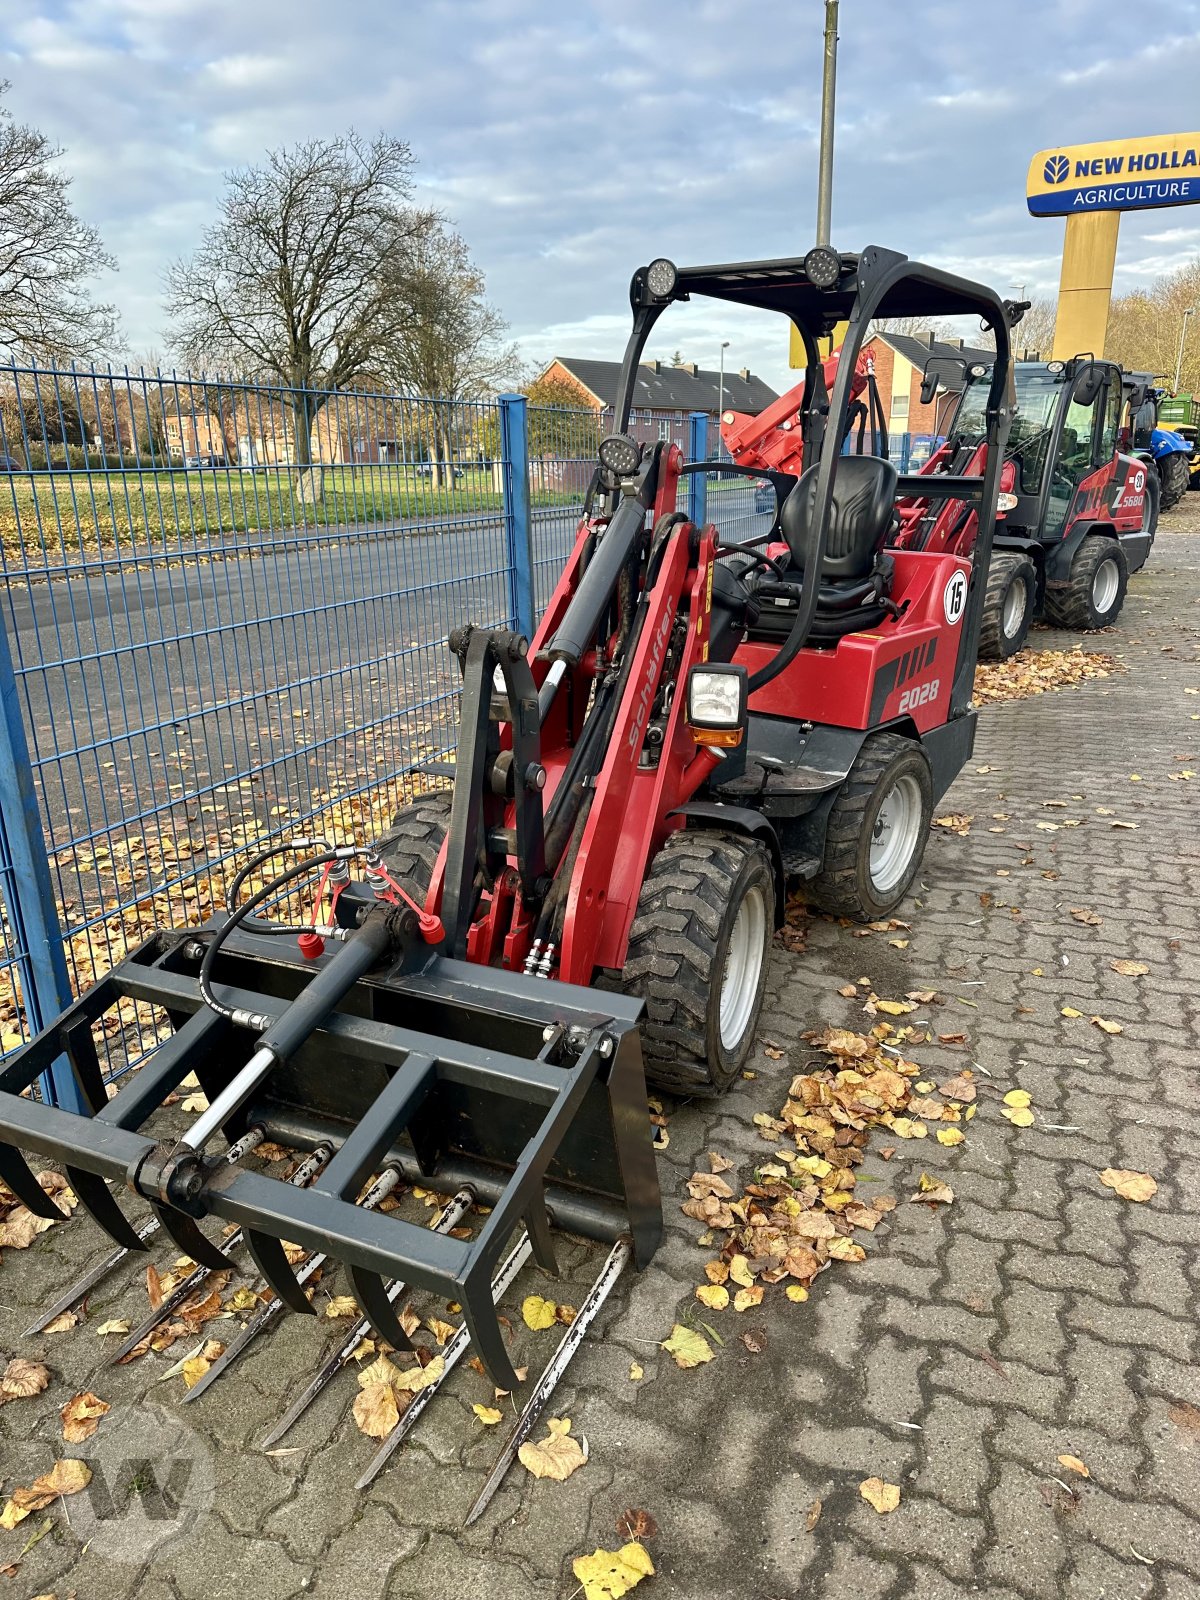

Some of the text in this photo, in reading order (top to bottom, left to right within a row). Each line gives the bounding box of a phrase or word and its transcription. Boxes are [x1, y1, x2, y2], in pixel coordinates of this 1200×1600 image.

[1075, 149, 1200, 177] NEW HOLLA
[1073, 182, 1190, 205] AGRICULTURE
[1112, 486, 1143, 508] Z 5680
[950, 581, 964, 614] 15
[628, 595, 673, 762] Schäffer
[898, 679, 940, 714] 2028
